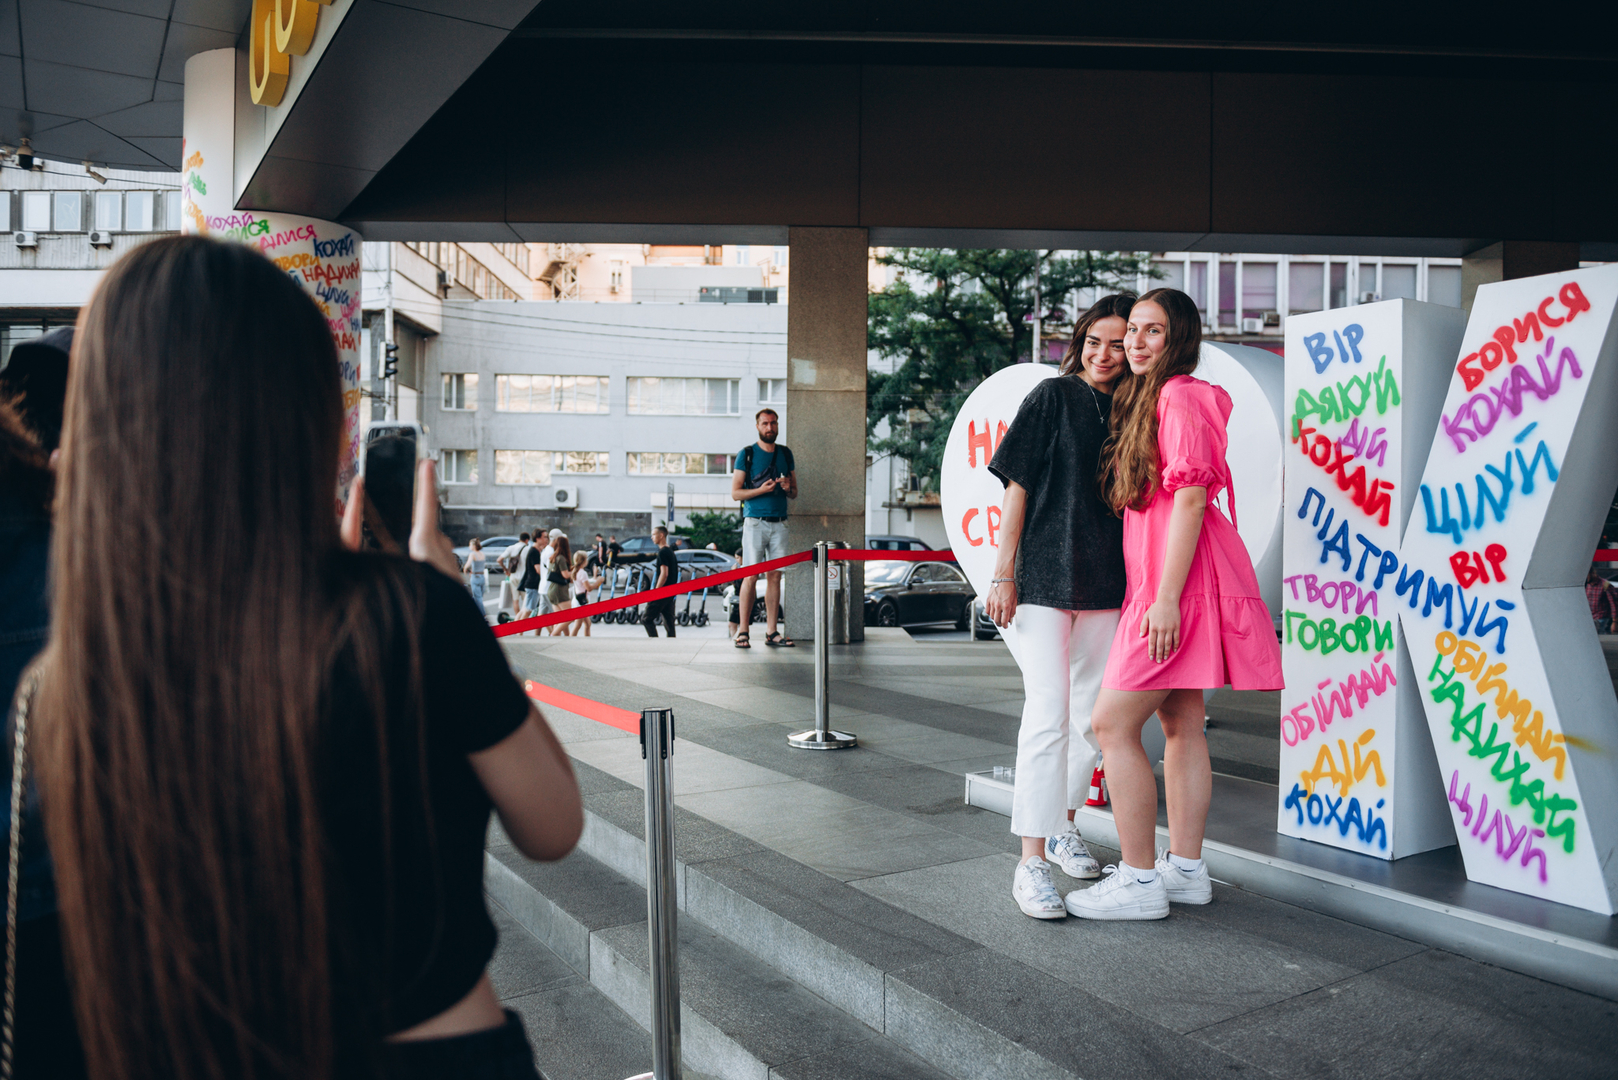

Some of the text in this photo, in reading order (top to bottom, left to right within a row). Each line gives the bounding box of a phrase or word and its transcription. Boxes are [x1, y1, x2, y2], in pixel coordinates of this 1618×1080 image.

[205, 212, 255, 231] КОХАЙ
[273, 252, 322, 271] ОВОРИ
[313, 232, 355, 258] КОХАЙ
[1303, 323, 1364, 374] ВІР
[1457, 281, 1591, 392] БОРИСЯ
[1291, 354, 1401, 444] ДЯКУЙ
[1441, 335, 1583, 454] КОХАЙ
[1291, 418, 1396, 527] КОХАЙ
[1419, 421, 1560, 545] ЦІЛУЙ
[1283, 573, 1379, 618] ТВОРИ
[1449, 542, 1508, 590] ВІР
[1285, 608, 1395, 656] ГОВОРИ
[1280, 651, 1398, 748] ОБІЙМАЙ
[1434, 630, 1568, 782] ОБІЙМАЙ
[1300, 728, 1386, 799] ДІЙ
[1427, 652, 1578, 854] НАДИХАЙ
[1284, 783, 1387, 850] КОХАЙ
[1448, 769, 1549, 884] ЦІЛУЙ
